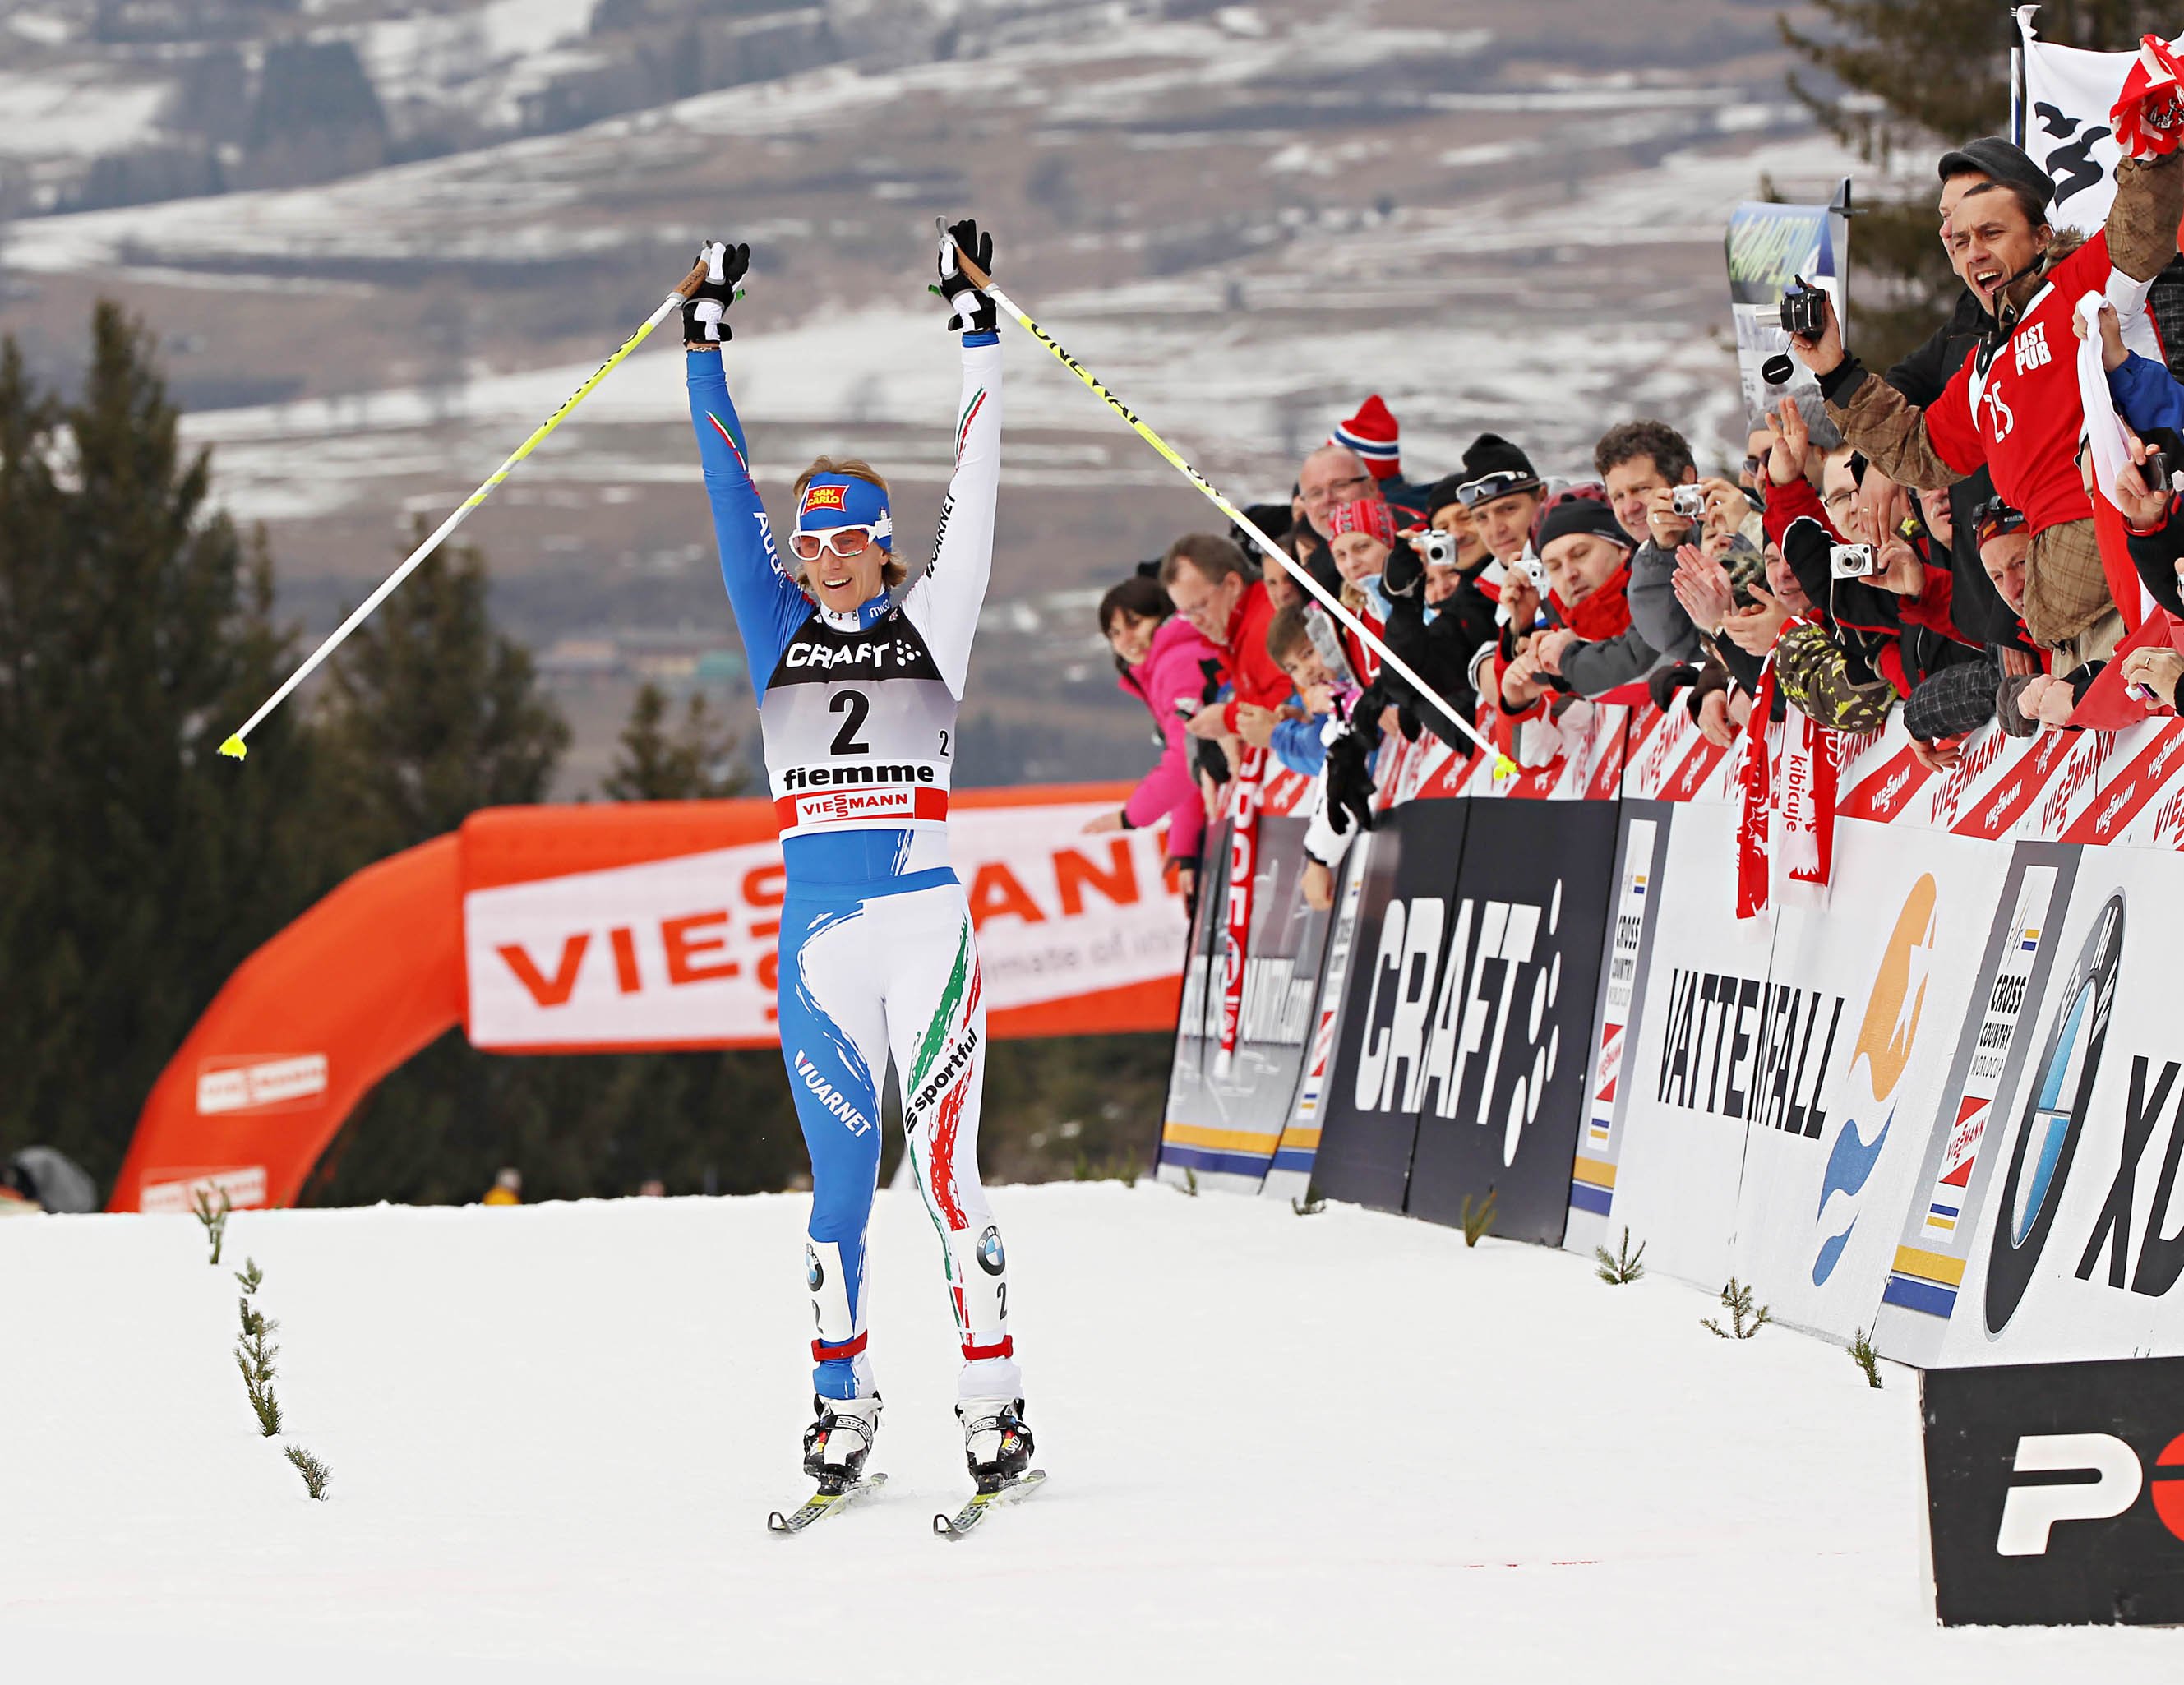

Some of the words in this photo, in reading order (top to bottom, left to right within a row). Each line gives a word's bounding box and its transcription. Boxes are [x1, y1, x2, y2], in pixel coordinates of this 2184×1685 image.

[2014, 321, 2045, 354] LAST
[2015, 341, 2052, 376] PUB
[1983, 380, 2014, 444] 25
[807, 495, 840, 506] CARLO
[813, 488, 836, 498] SAN
[785, 641, 890, 670] CRAFT
[829, 689, 870, 756] 2
[939, 729, 949, 757] 2
[783, 764, 935, 791] fiemme
[1782, 754, 1808, 833] kibicuje
[1872, 764, 1911, 813] VIESSMANN
[802, 793, 908, 818] VIESSMANN
[1984, 778, 2023, 830] VIESSMANN
[2095, 780, 2136, 835] VIESSMANN
[1355, 897, 1542, 1126] CRAFT
[1990, 973, 2027, 1015] CROSS
[1657, 968, 1845, 1141] VATTENFALL
[1979, 1021, 2014, 1050] COUNTRY
[914, 1027, 979, 1112] sportful
[997, 1281, 1008, 1321] 2
